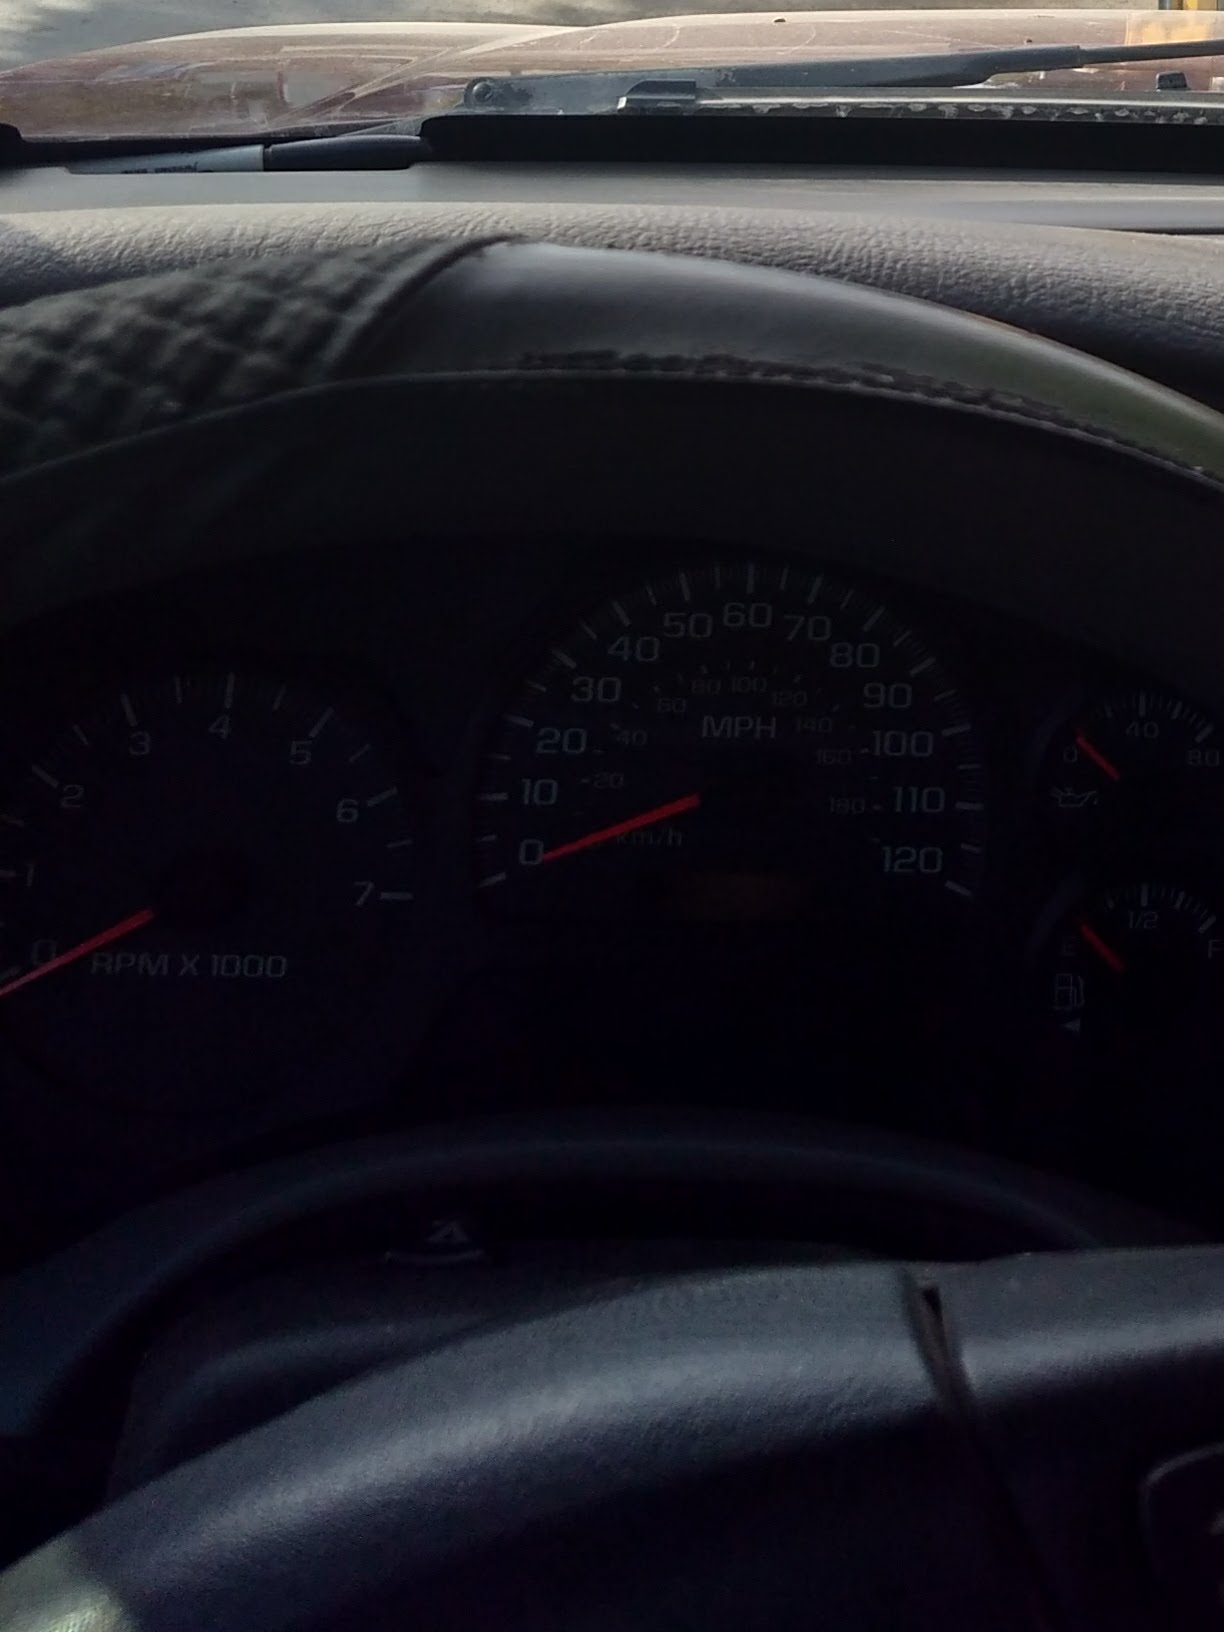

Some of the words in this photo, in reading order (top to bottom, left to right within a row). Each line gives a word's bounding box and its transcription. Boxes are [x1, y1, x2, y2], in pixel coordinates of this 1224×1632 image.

[664, 612, 713, 639] 50
[722, 602, 773, 629] 60
[783, 614, 832, 642] 70
[608, 636, 660, 663] 40
[830, 641, 881, 669] 80
[571, 676, 621, 704] 30
[863, 682, 913, 710] 90
[209, 714, 233, 740] 4
[702, 716, 777, 740] MPH
[1125, 720, 1160, 738] 40
[128, 730, 151, 756] 3
[288, 739, 312, 766] 5
[536, 728, 588, 755] 20
[873, 730, 935, 757] 100
[60, 783, 86, 809] 2
[521, 779, 559, 806] 10
[894, 785, 945, 813] 110
[335, 797, 359, 824] 6
[518, 840, 544, 867] 0
[882, 846, 944, 873] 120
[25, 862, 37, 888] 1
[354, 880, 377, 907] 7
[1128, 911, 1160, 929] 1/2
[1207, 939, 1224, 960] F
[90, 952, 169, 977] RPM
[178, 953, 201, 977] X
[211, 952, 288, 979] 1000
